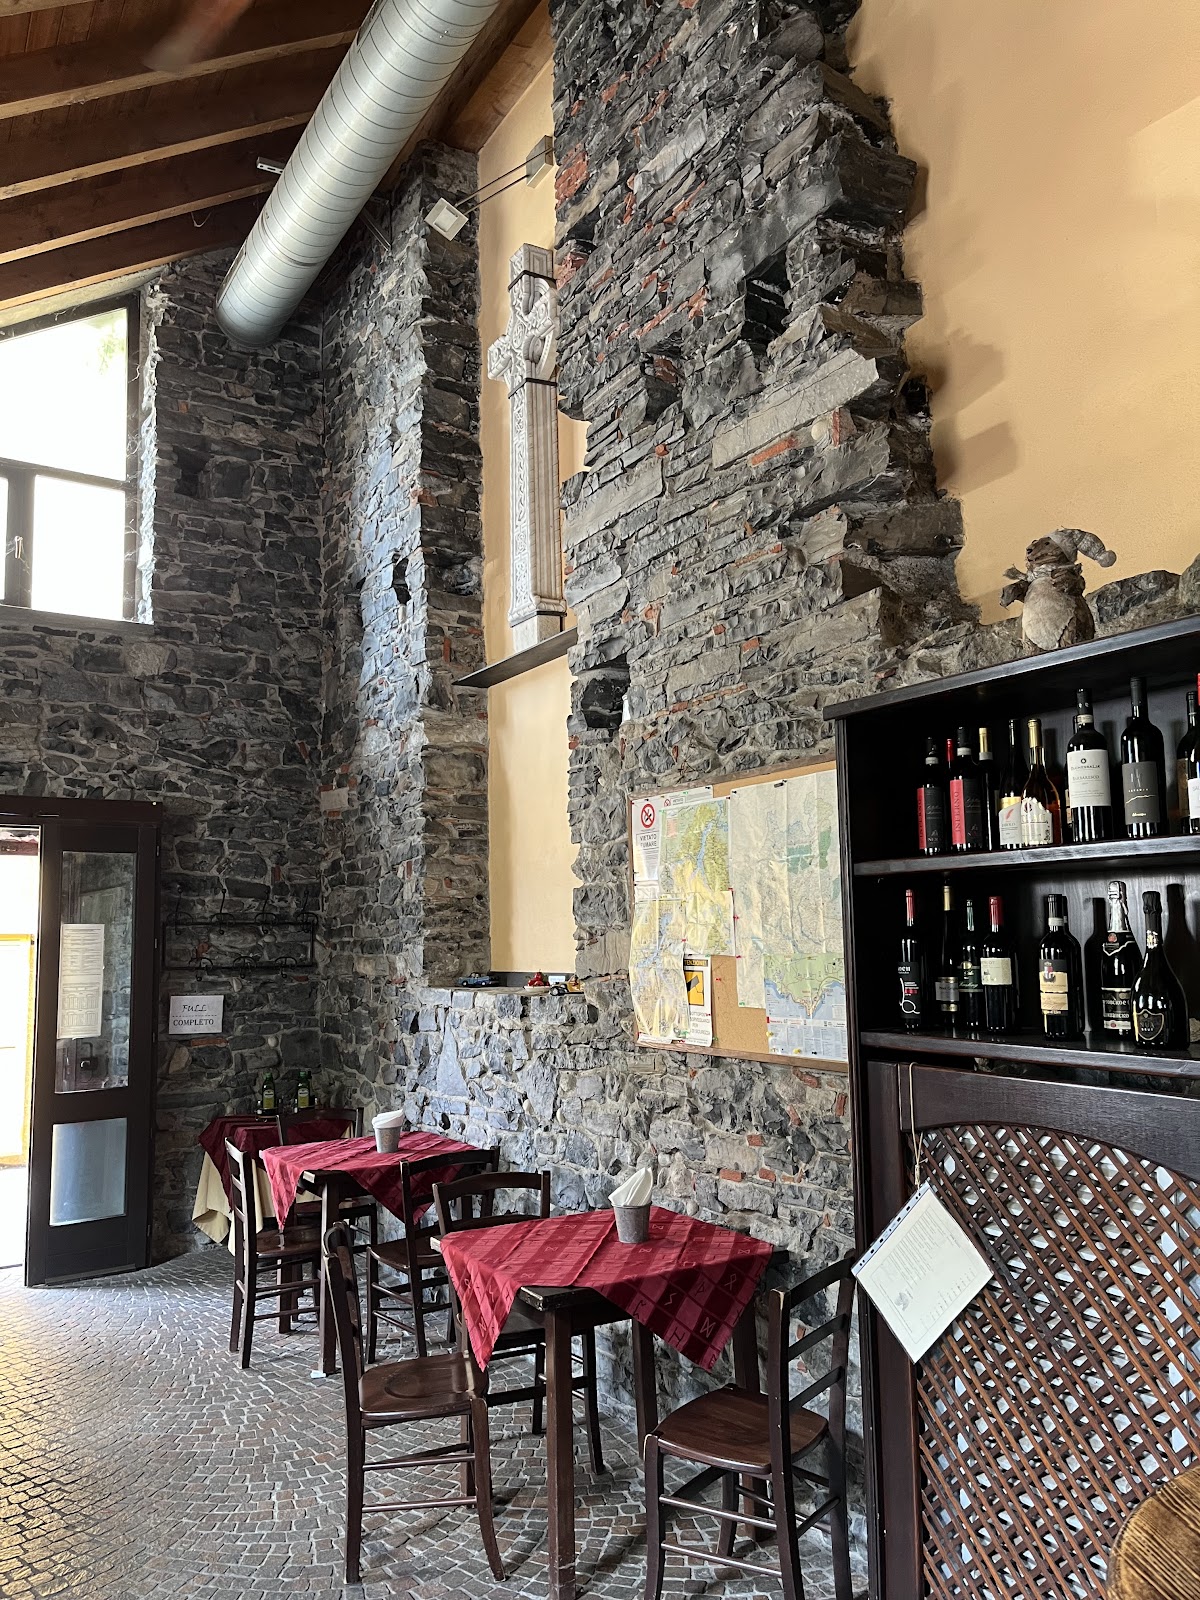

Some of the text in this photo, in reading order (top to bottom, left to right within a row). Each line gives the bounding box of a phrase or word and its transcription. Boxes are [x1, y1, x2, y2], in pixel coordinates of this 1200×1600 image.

[640, 840, 657, 848] FUMARE
[182, 1004, 207, 1012] FULL
[172, 1018, 214, 1026] COMPLETO
